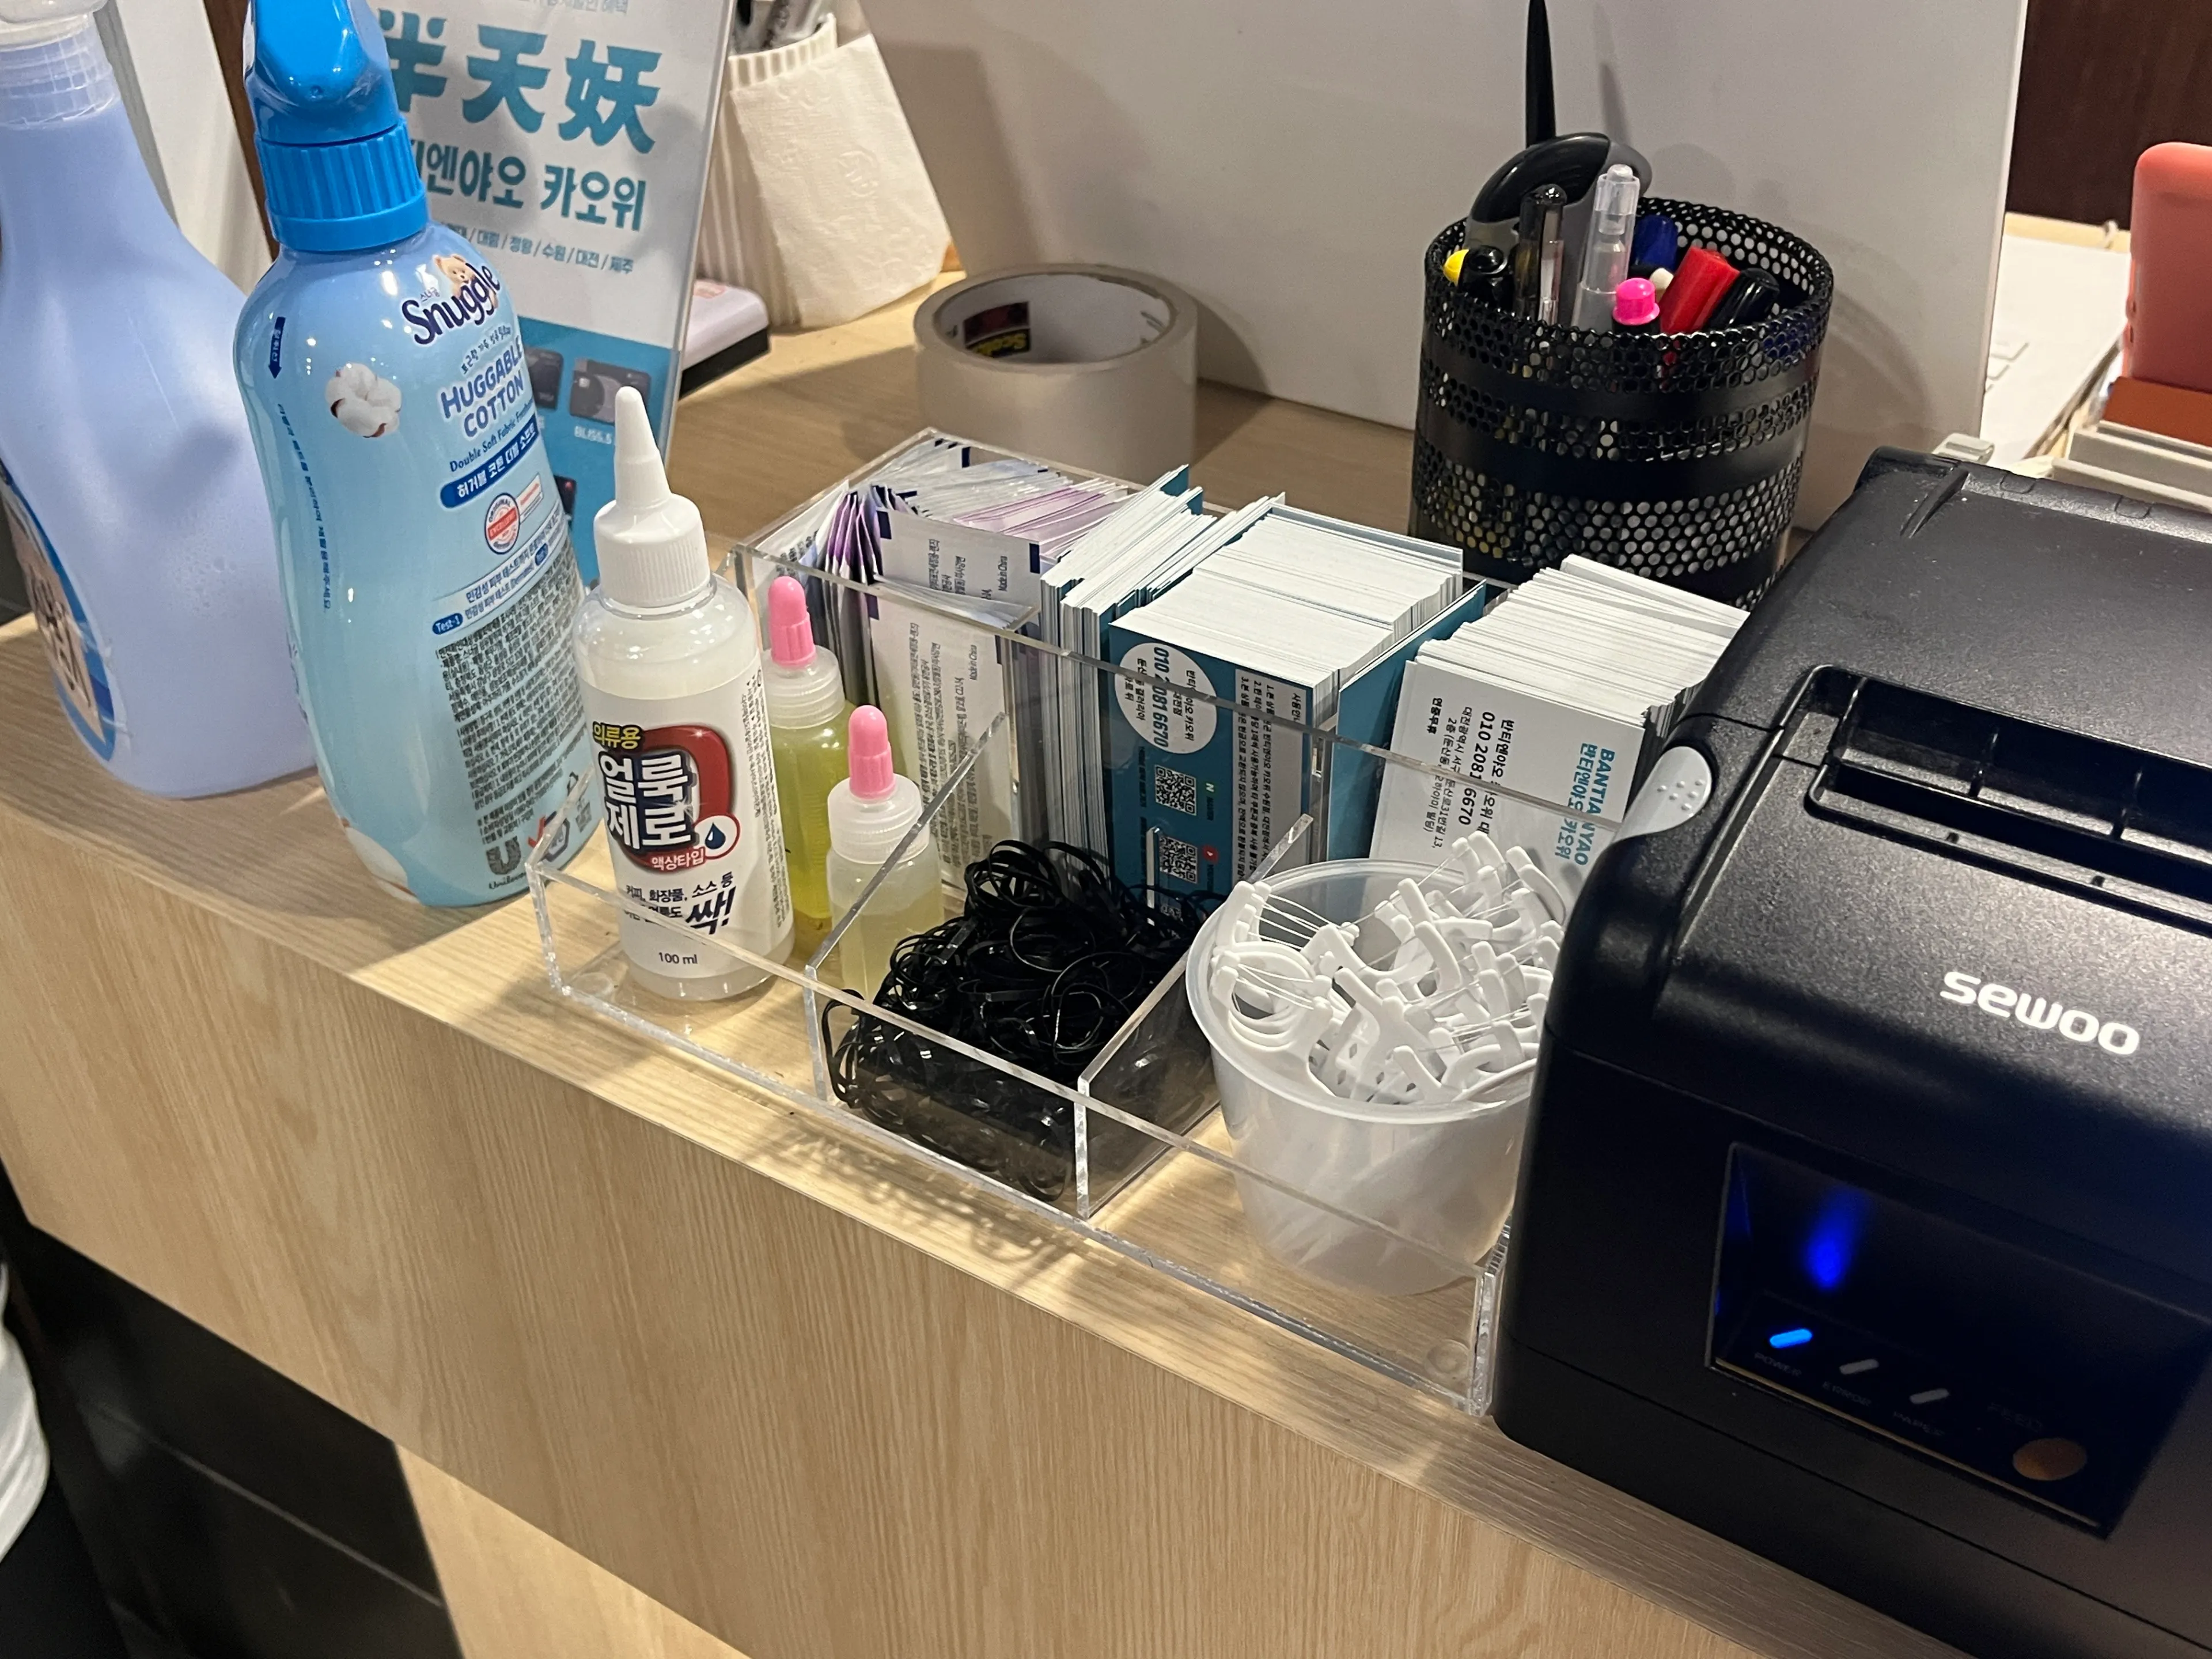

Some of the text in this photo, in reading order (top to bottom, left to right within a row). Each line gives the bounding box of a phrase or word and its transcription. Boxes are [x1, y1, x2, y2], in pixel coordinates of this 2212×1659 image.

[540, 164, 646, 231] 카오위
[543, 243, 566, 261] 수원
[576, 248, 599, 268] 대전
[402, 263, 500, 344] Snuggle
[464, 370, 524, 438] COTTON
[449, 448, 482, 472] Double
[483, 436, 497, 453] Soft
[1154, 646, 1169, 673] 010
[1184, 671, 1196, 714] 반티야오
[1153, 712, 1169, 748] 6670
[1426, 698, 1443, 734] 연중무휴
[1446, 717, 1457, 733] 2층
[1455, 706, 1472, 753] 대전광역시
[593, 724, 641, 749] 의류용
[1491, 719, 1514, 778] 반티엔야오
[600, 755, 687, 804] 얼룩
[1458, 711, 1495, 825] 010 2081 6670
[1555, 743, 1598, 860] 반티엔야오 카오위
[1574, 748, 1615, 865] BANTIANYAO
[607, 804, 691, 849] 제로
[1431, 836, 1443, 848] 13,
[652, 847, 706, 870] 액상타입
[649, 888, 688, 903] 화장품,
[692, 881, 718, 897] 소스
[721, 872, 733, 888] 등
[659, 952, 698, 964] 100 ml
